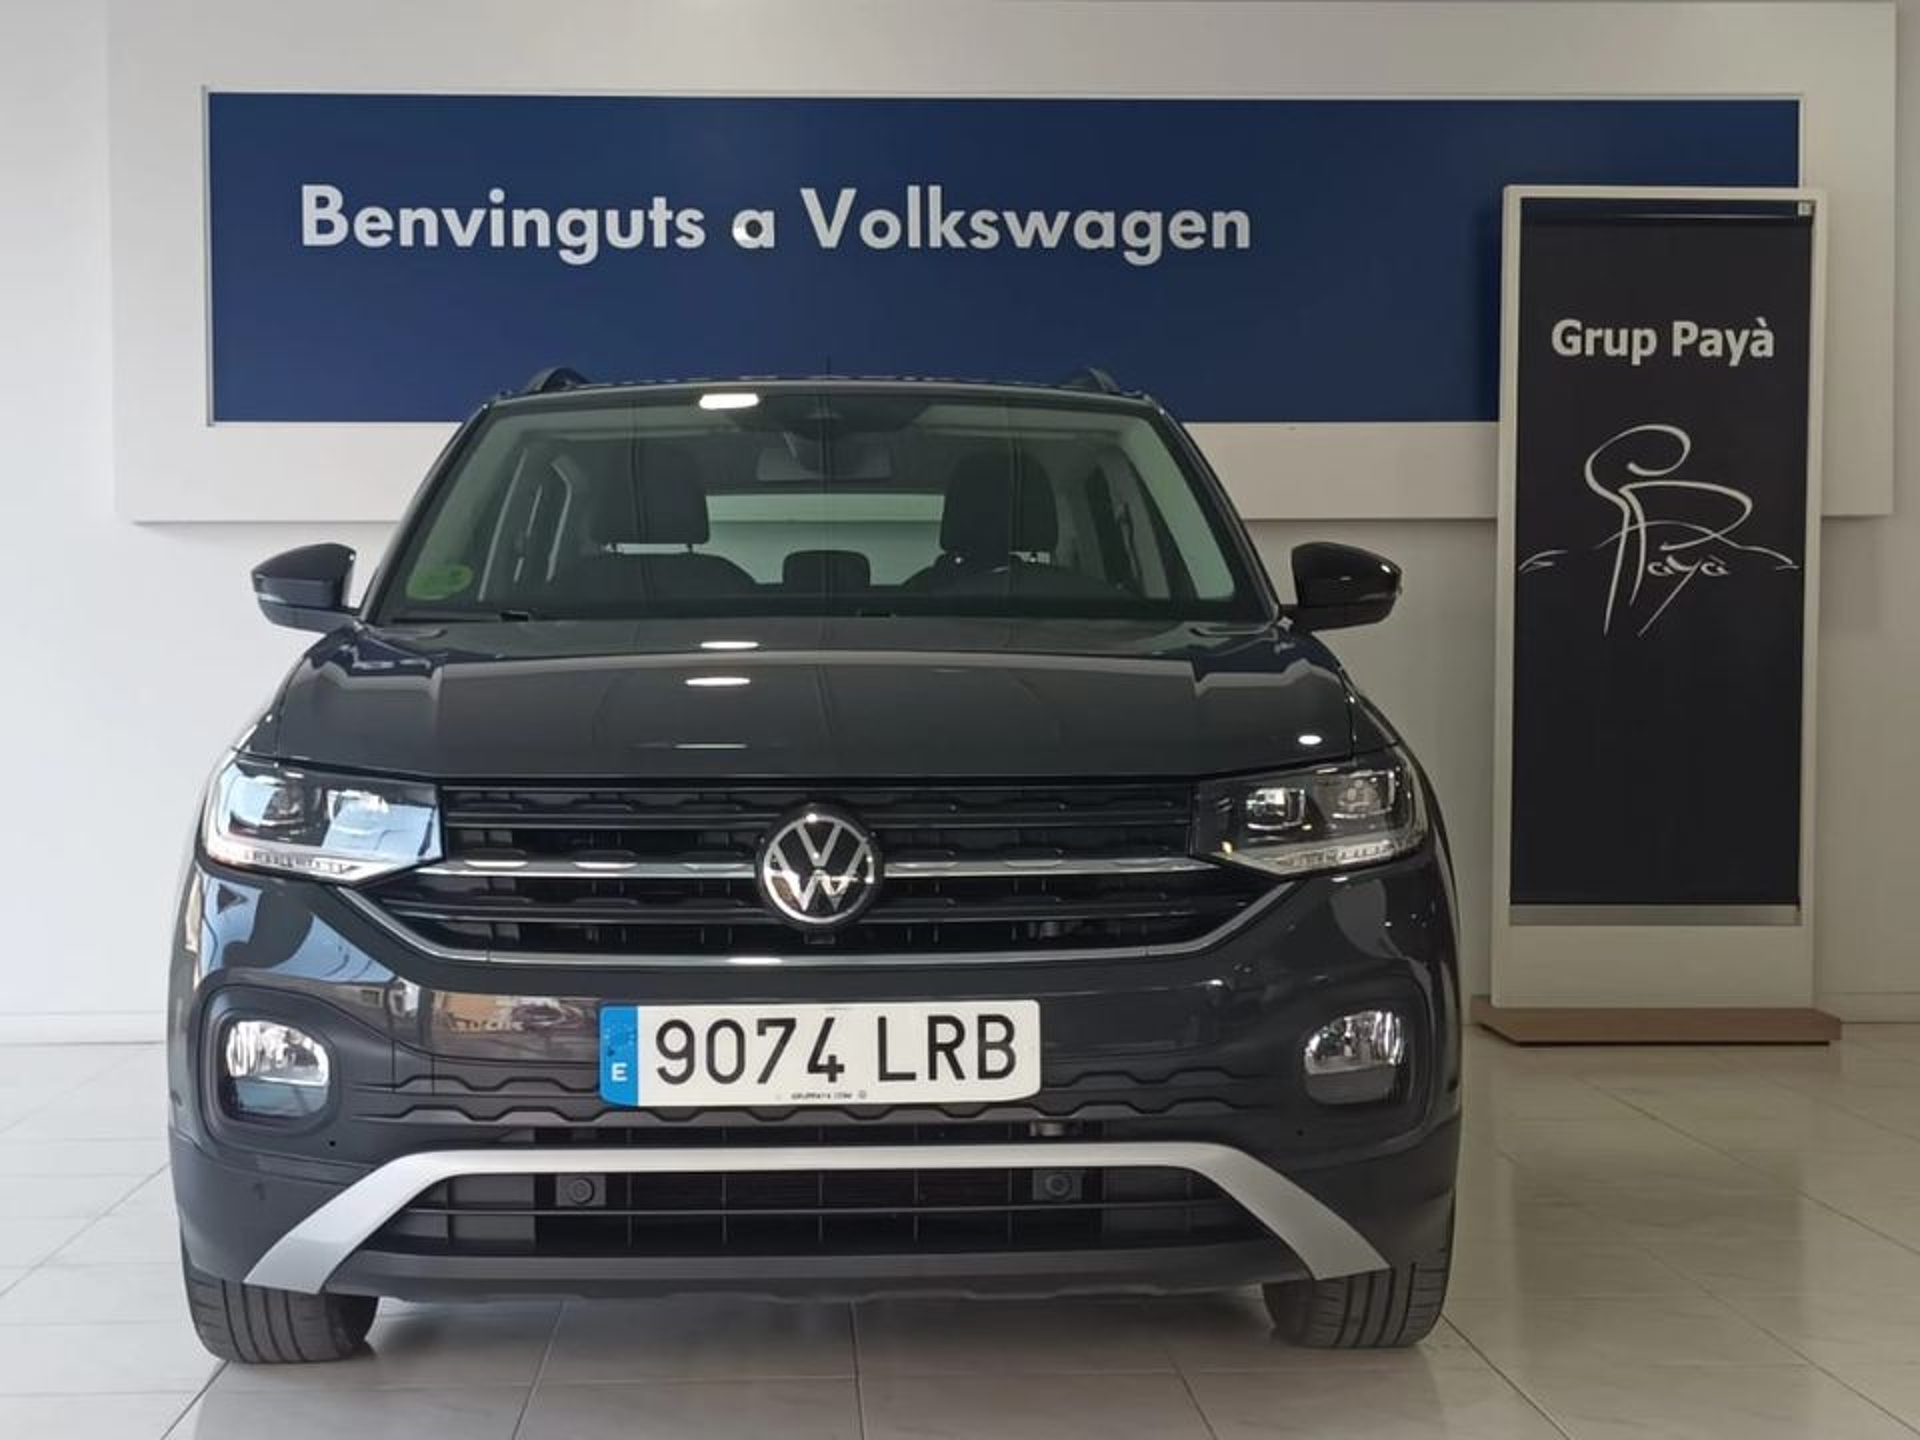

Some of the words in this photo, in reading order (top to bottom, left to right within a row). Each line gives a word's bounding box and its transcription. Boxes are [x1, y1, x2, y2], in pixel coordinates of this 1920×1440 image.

[301, 184, 706, 266] Benvinguts
[731, 208, 775, 250] a
[800, 185, 1251, 266] Volkswagen
[1551, 318, 1658, 366] Grup
[1671, 316, 1776, 367] Payà
[612, 1063, 627, 1081] E
[655, 1017, 845, 1085] 9074
[877, 1014, 1017, 1082] LRB
